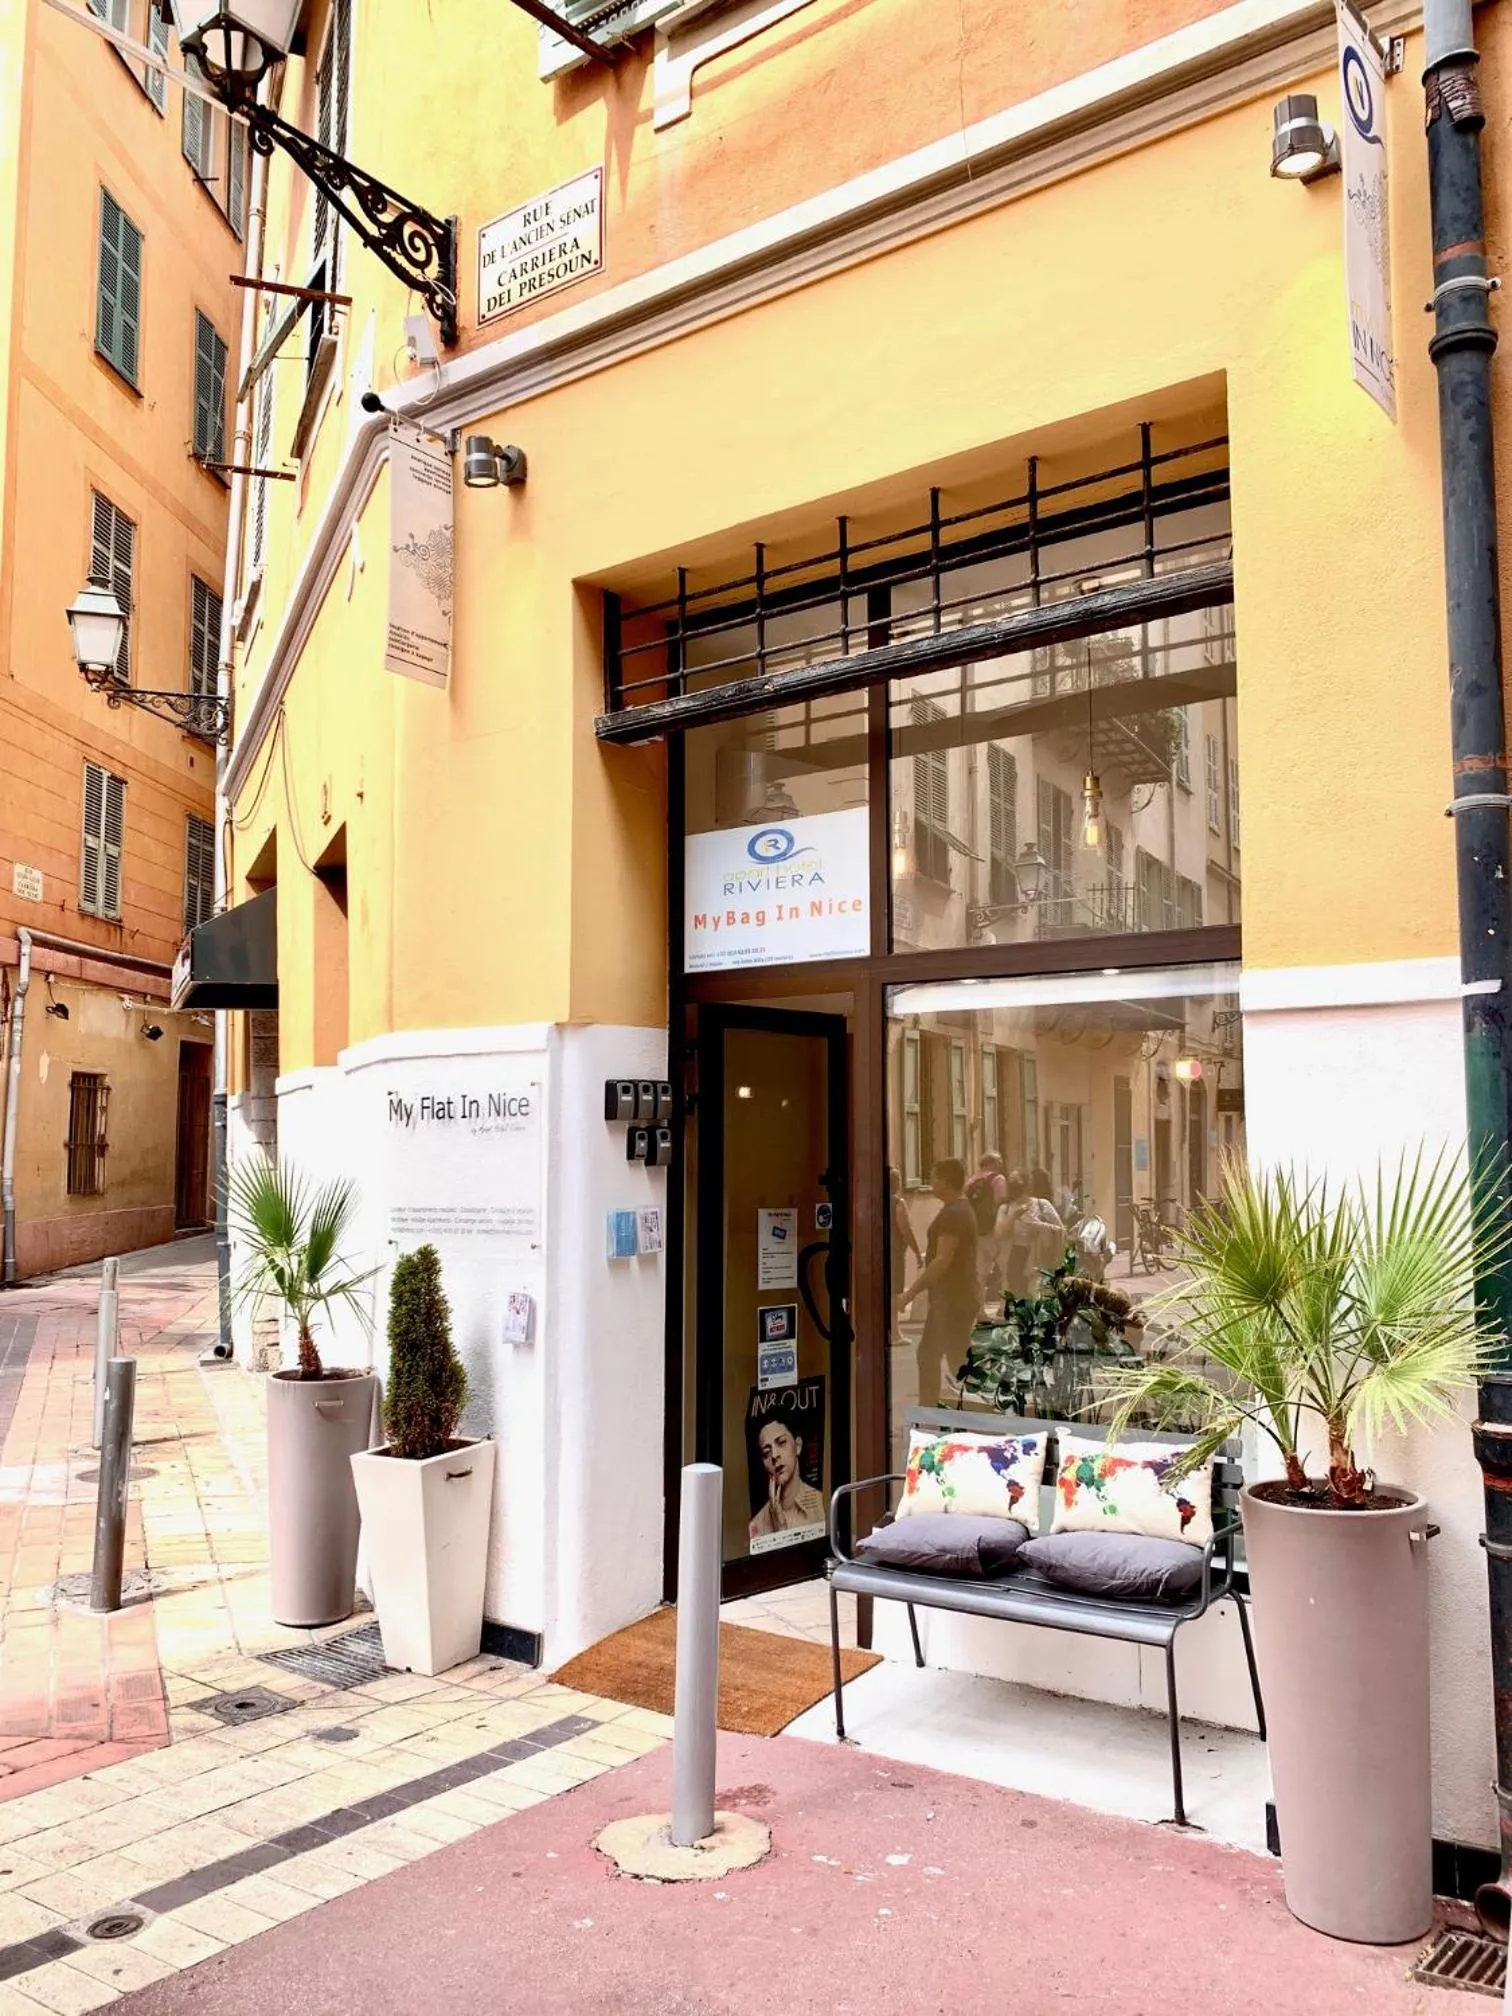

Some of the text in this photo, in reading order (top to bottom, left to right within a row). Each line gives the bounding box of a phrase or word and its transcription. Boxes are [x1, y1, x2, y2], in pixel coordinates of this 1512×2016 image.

[523, 201, 552, 228] RUE
[482, 250, 497, 269] DE
[500, 219, 555, 259] L'ANCIEN
[497, 236, 581, 287] CARRIERA
[486, 250, 593, 313] DEI PRESOUN
[723, 872, 826, 896] RIVIERA
[776, 904, 800, 922] In
[811, 897, 862, 917] Nice
[389, 1092, 530, 1128] My Flat In Nice
